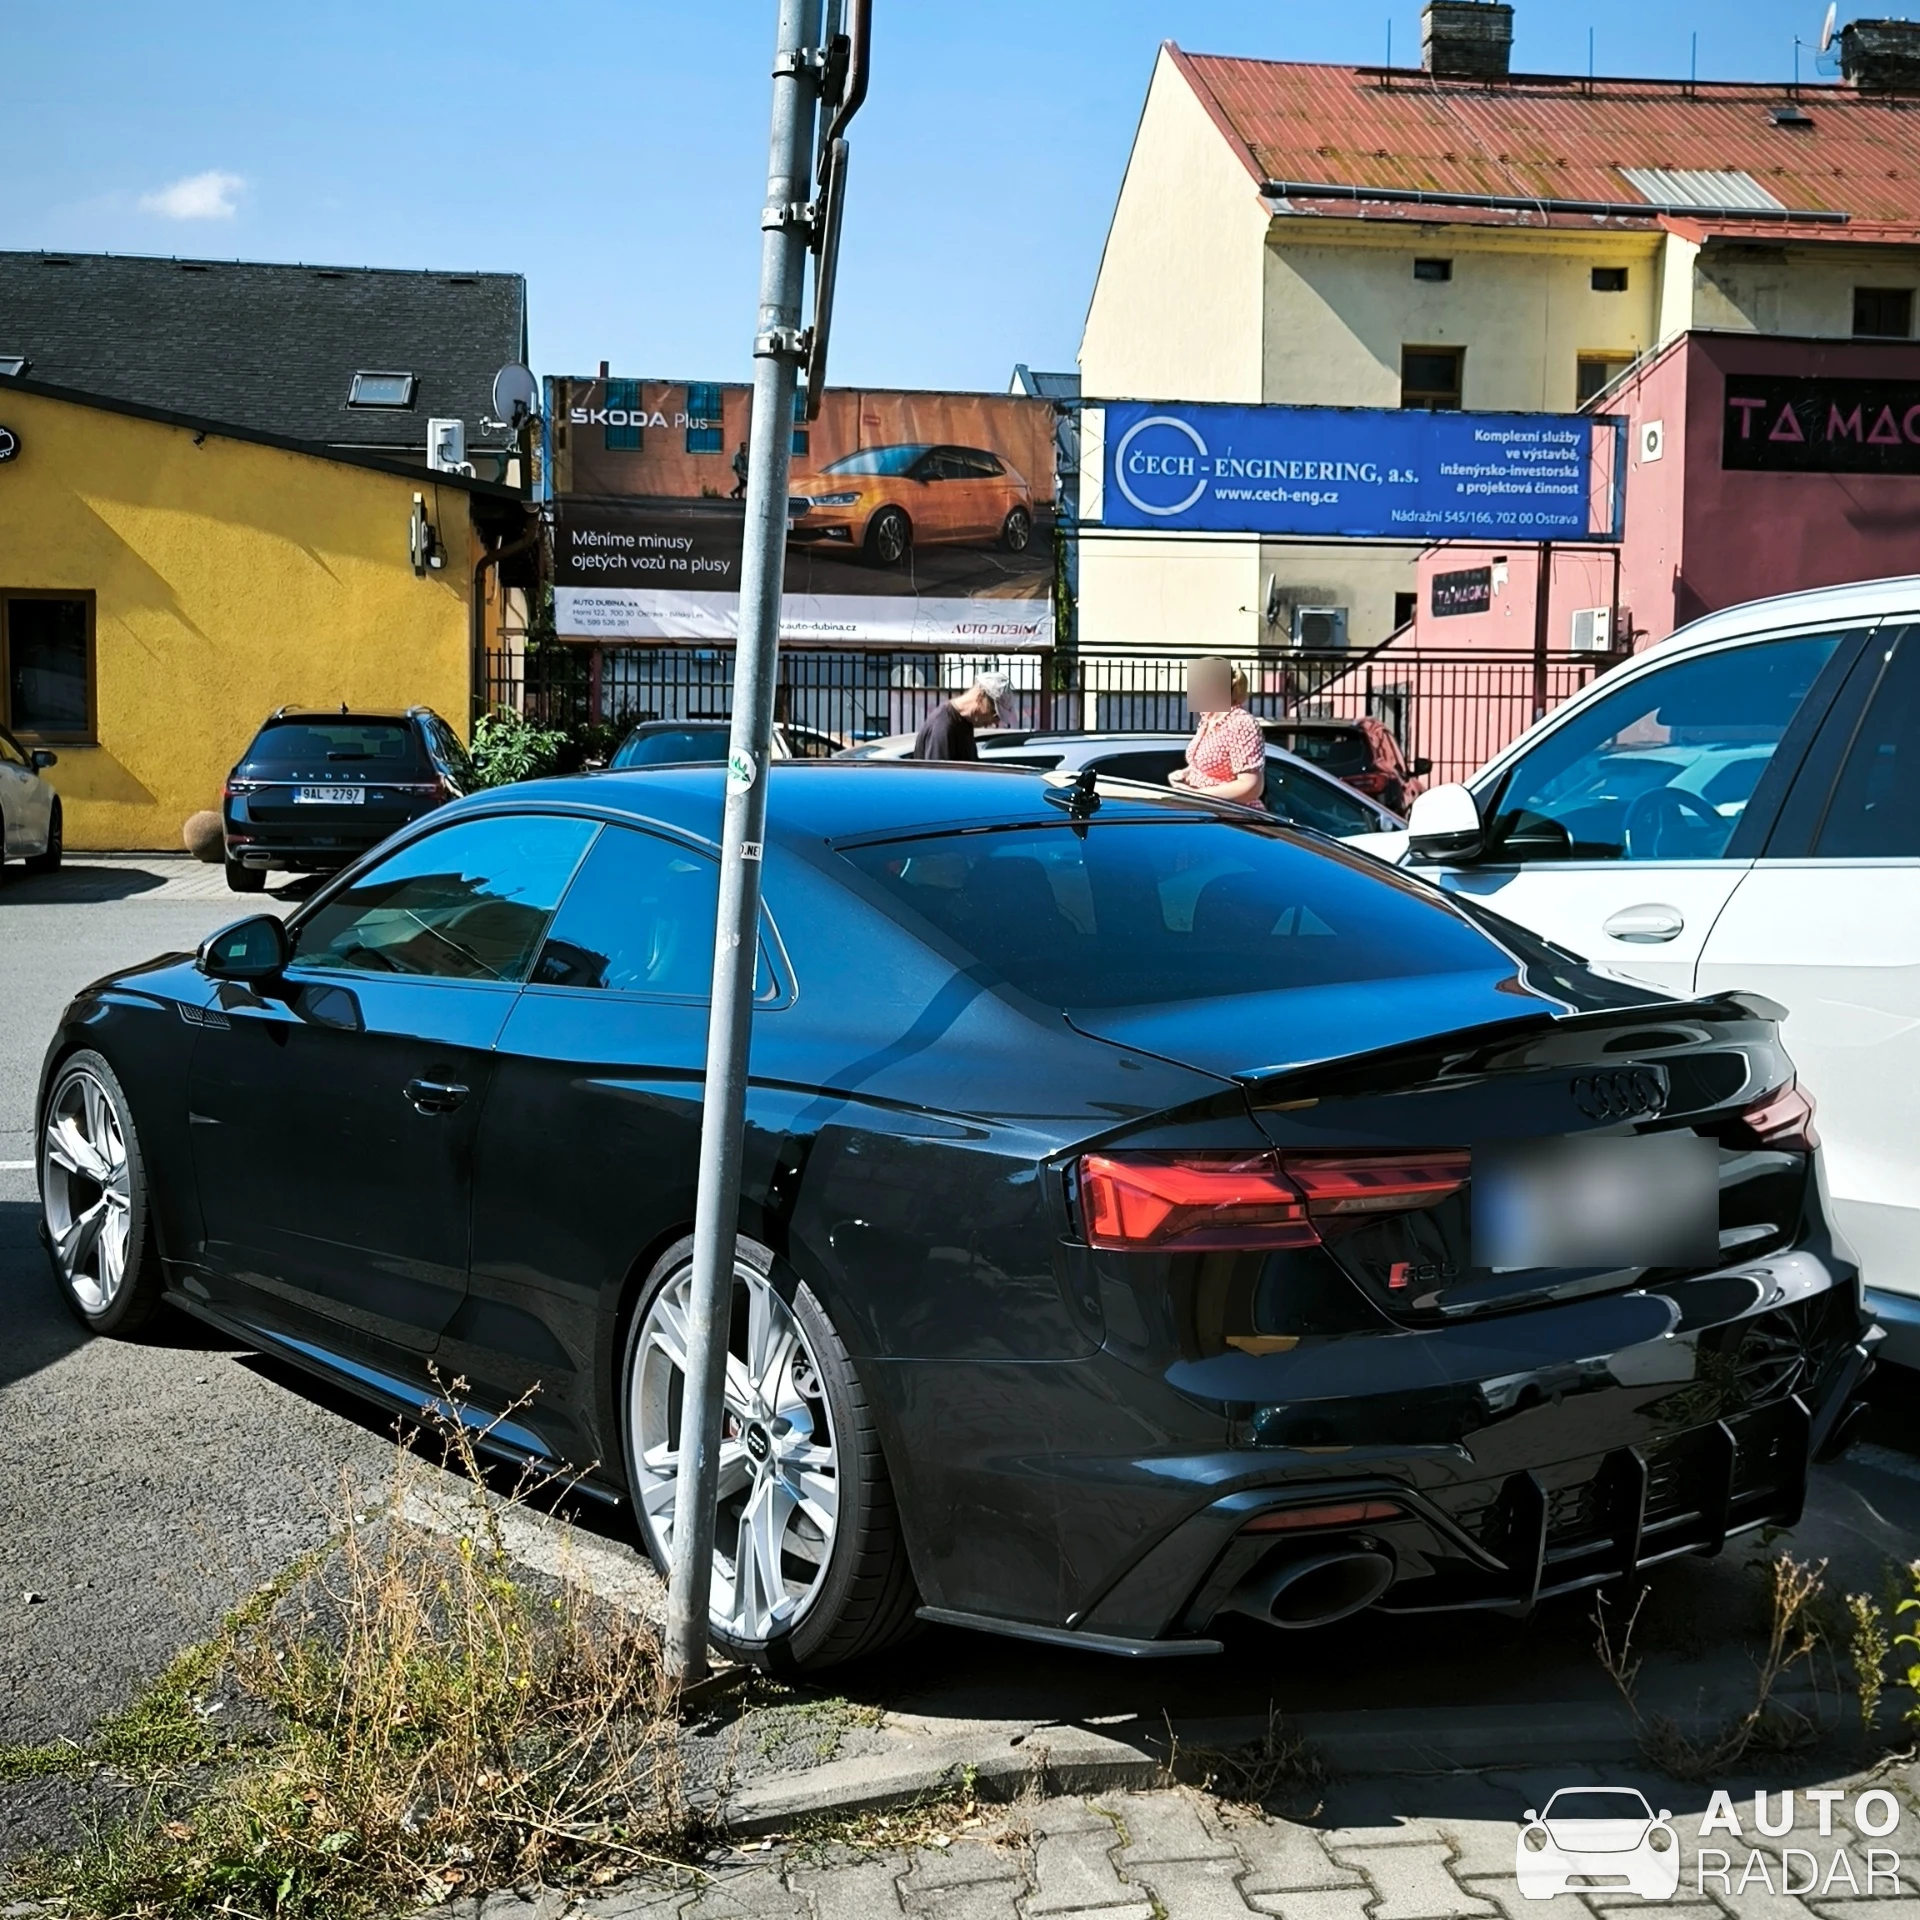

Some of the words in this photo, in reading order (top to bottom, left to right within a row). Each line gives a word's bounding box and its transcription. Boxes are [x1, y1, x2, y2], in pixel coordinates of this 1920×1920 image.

[674, 411, 708, 430] Plus
[1474, 429, 1539, 444] Komplexní
[1542, 430, 1581, 446] služby
[1506, 450, 1520, 459] ve
[1522, 448, 1580, 462] výstavbě,
[1129, 450, 1195, 476] ČECH
[1215, 458, 1383, 486] ENGINEERING,
[1388, 468, 1420, 484] a.s.
[1440, 463, 1580, 478] inženýrsko-investorská
[1215, 487, 1339, 506] www.cech-eng.cz
[1456, 483, 1464, 493] a
[1466, 481, 1532, 496] projektová
[1534, 482, 1579, 495] činnost
[1391, 509, 1442, 522] Nádražní
[1444, 510, 1494, 525] 545/166,
[1496, 511, 1518, 524] 702
[1519, 512, 1533, 524] 00
[1535, 513, 1579, 525] Ostrava
[572, 530, 635, 548] Měníme
[638, 534, 693, 552] minusy
[571, 553, 627, 571] ojetých
[630, 555, 666, 570] vozů
[670, 559, 687, 570] na
[691, 557, 731, 574] plusy
[303, 788, 324, 800] 9AL
[332, 788, 360, 800] 2797
